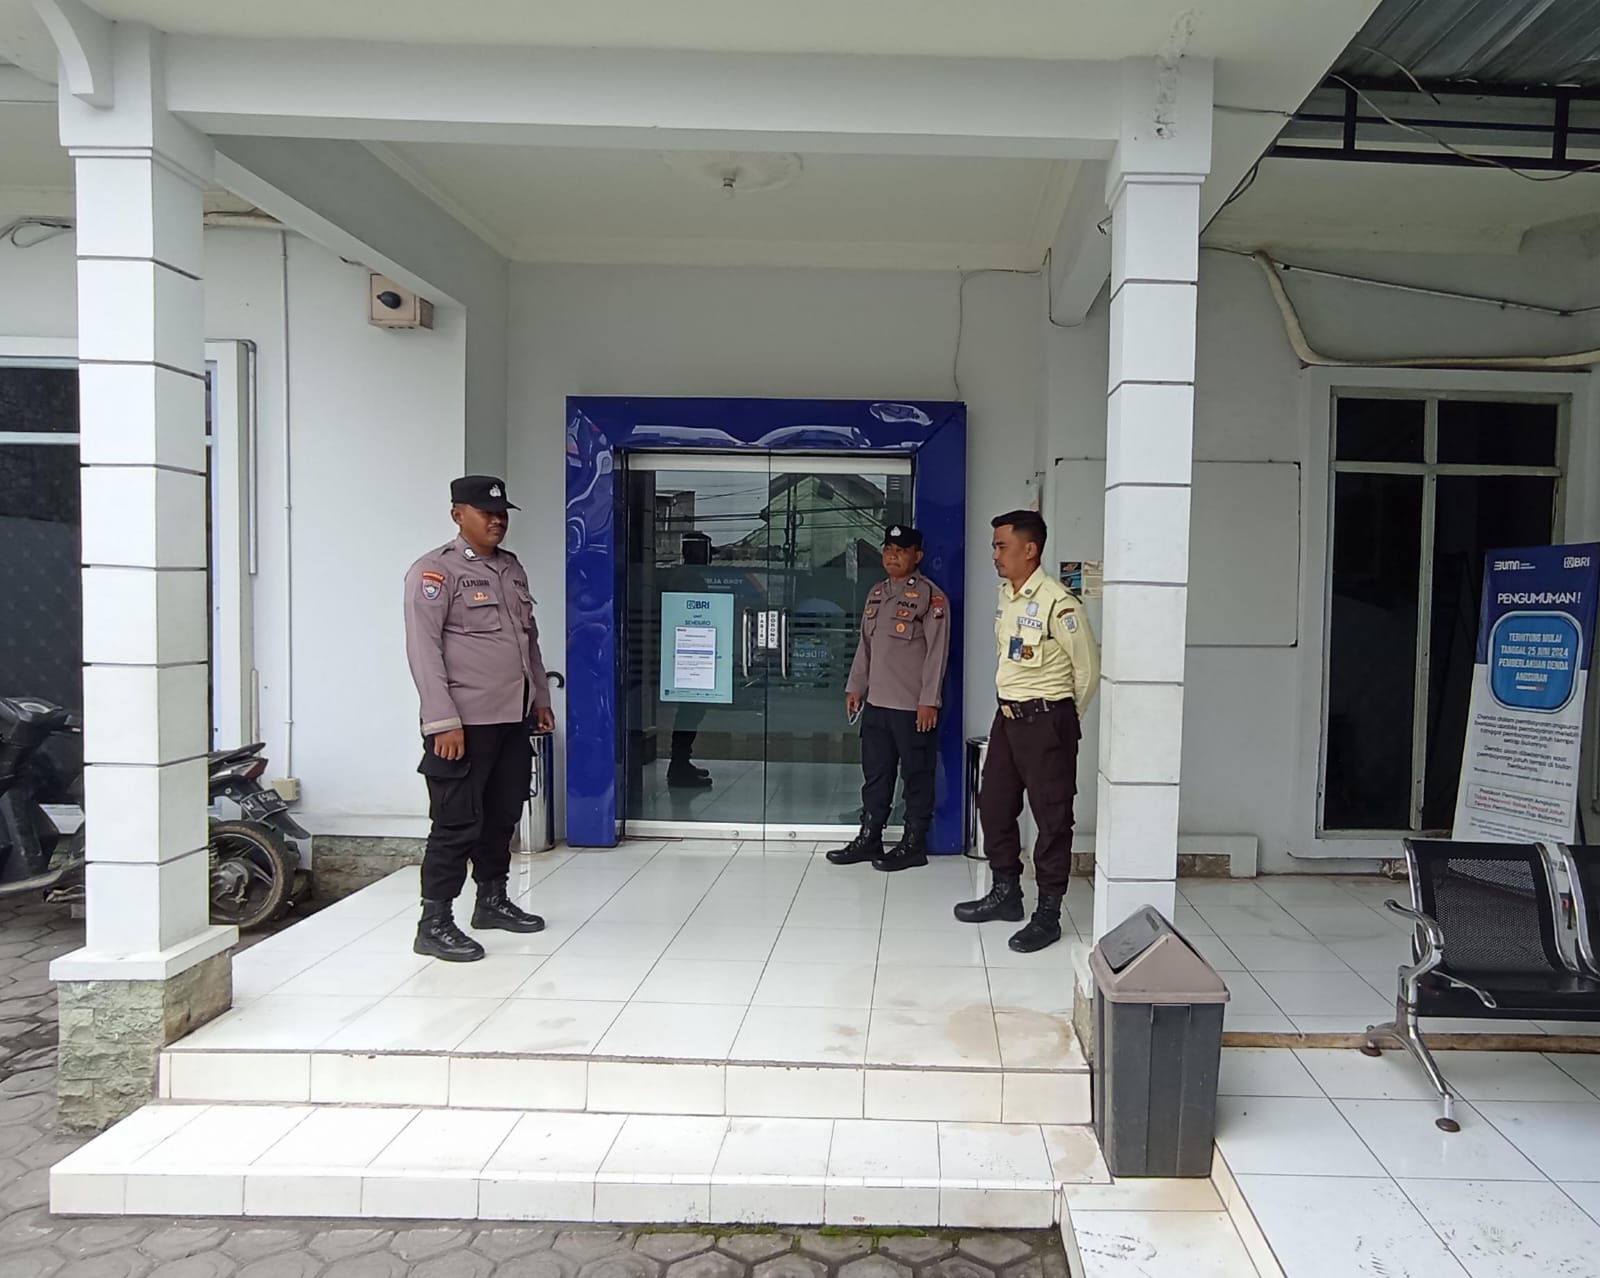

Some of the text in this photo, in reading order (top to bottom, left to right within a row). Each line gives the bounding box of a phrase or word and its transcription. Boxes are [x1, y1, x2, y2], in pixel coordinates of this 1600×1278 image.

[896, 600, 918, 609] POLRI
[1542, 633, 1562, 642] MULAI
[1501, 645, 1526, 655] TANGGAL
[1528, 646, 1536, 655] 25
[1551, 647, 1568, 657] 2024
[1498, 658, 1568, 670] PEMBERLAKUAN DENDA
[1515, 672, 1547, 682] ANGSURAN
